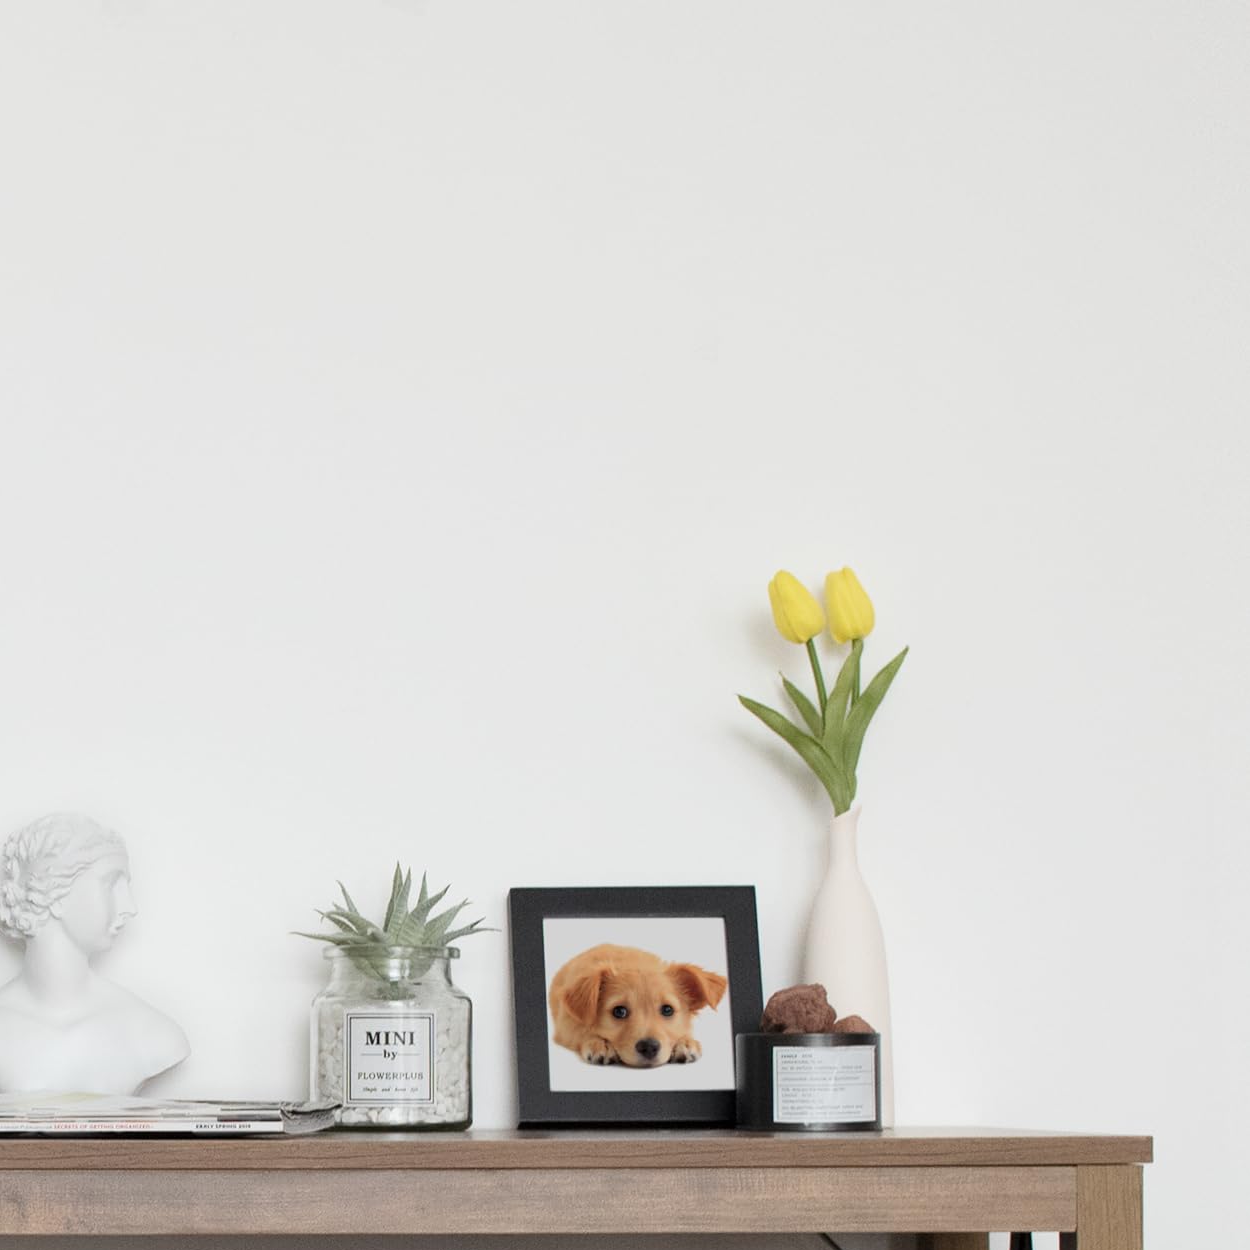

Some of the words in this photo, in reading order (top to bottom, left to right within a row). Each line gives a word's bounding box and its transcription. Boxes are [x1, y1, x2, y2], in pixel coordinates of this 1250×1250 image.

[365, 1031, 415, 1046] MINI
[383, 1049, 397, 1061] by
[357, 1071, 424, 1081] FLOWERPLUS
